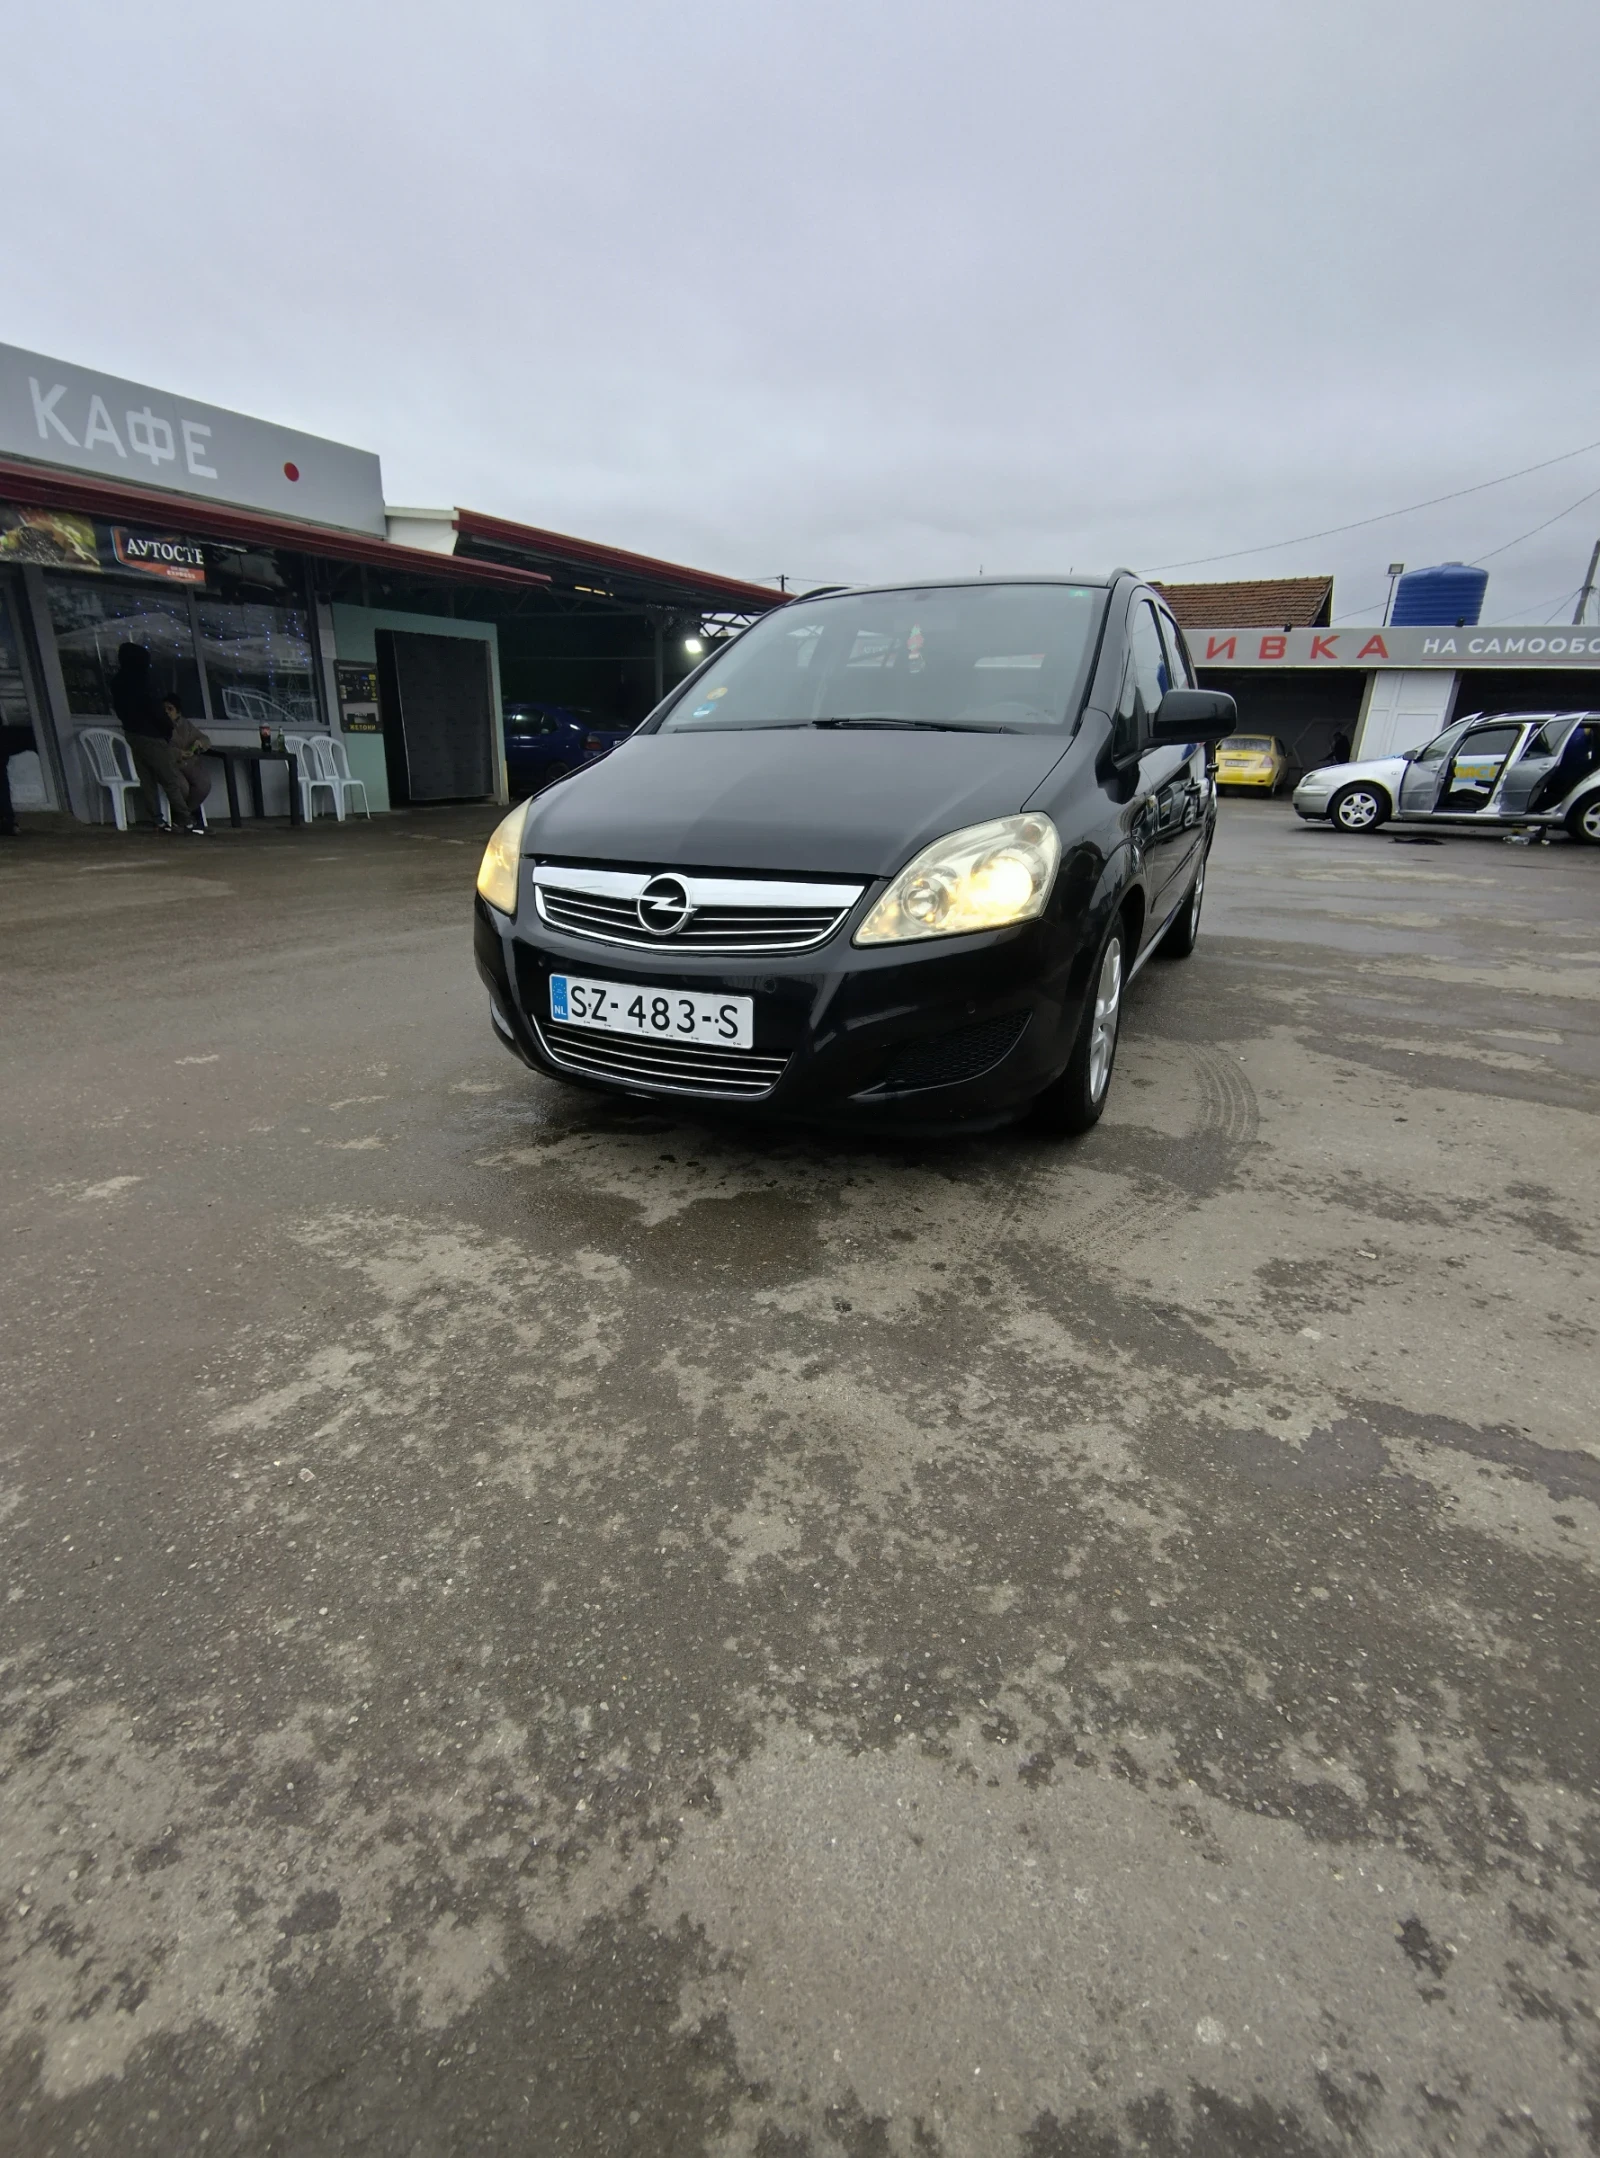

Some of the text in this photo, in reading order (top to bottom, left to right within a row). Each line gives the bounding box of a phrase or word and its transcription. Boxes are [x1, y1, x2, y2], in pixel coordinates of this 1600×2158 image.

[28, 376, 218, 479] КАФЕ
[1205, 635, 1389, 660] ИВКА
[1422, 638, 1459, 654] НА
[554, 985, 739, 1039] NL SZ-483-S
